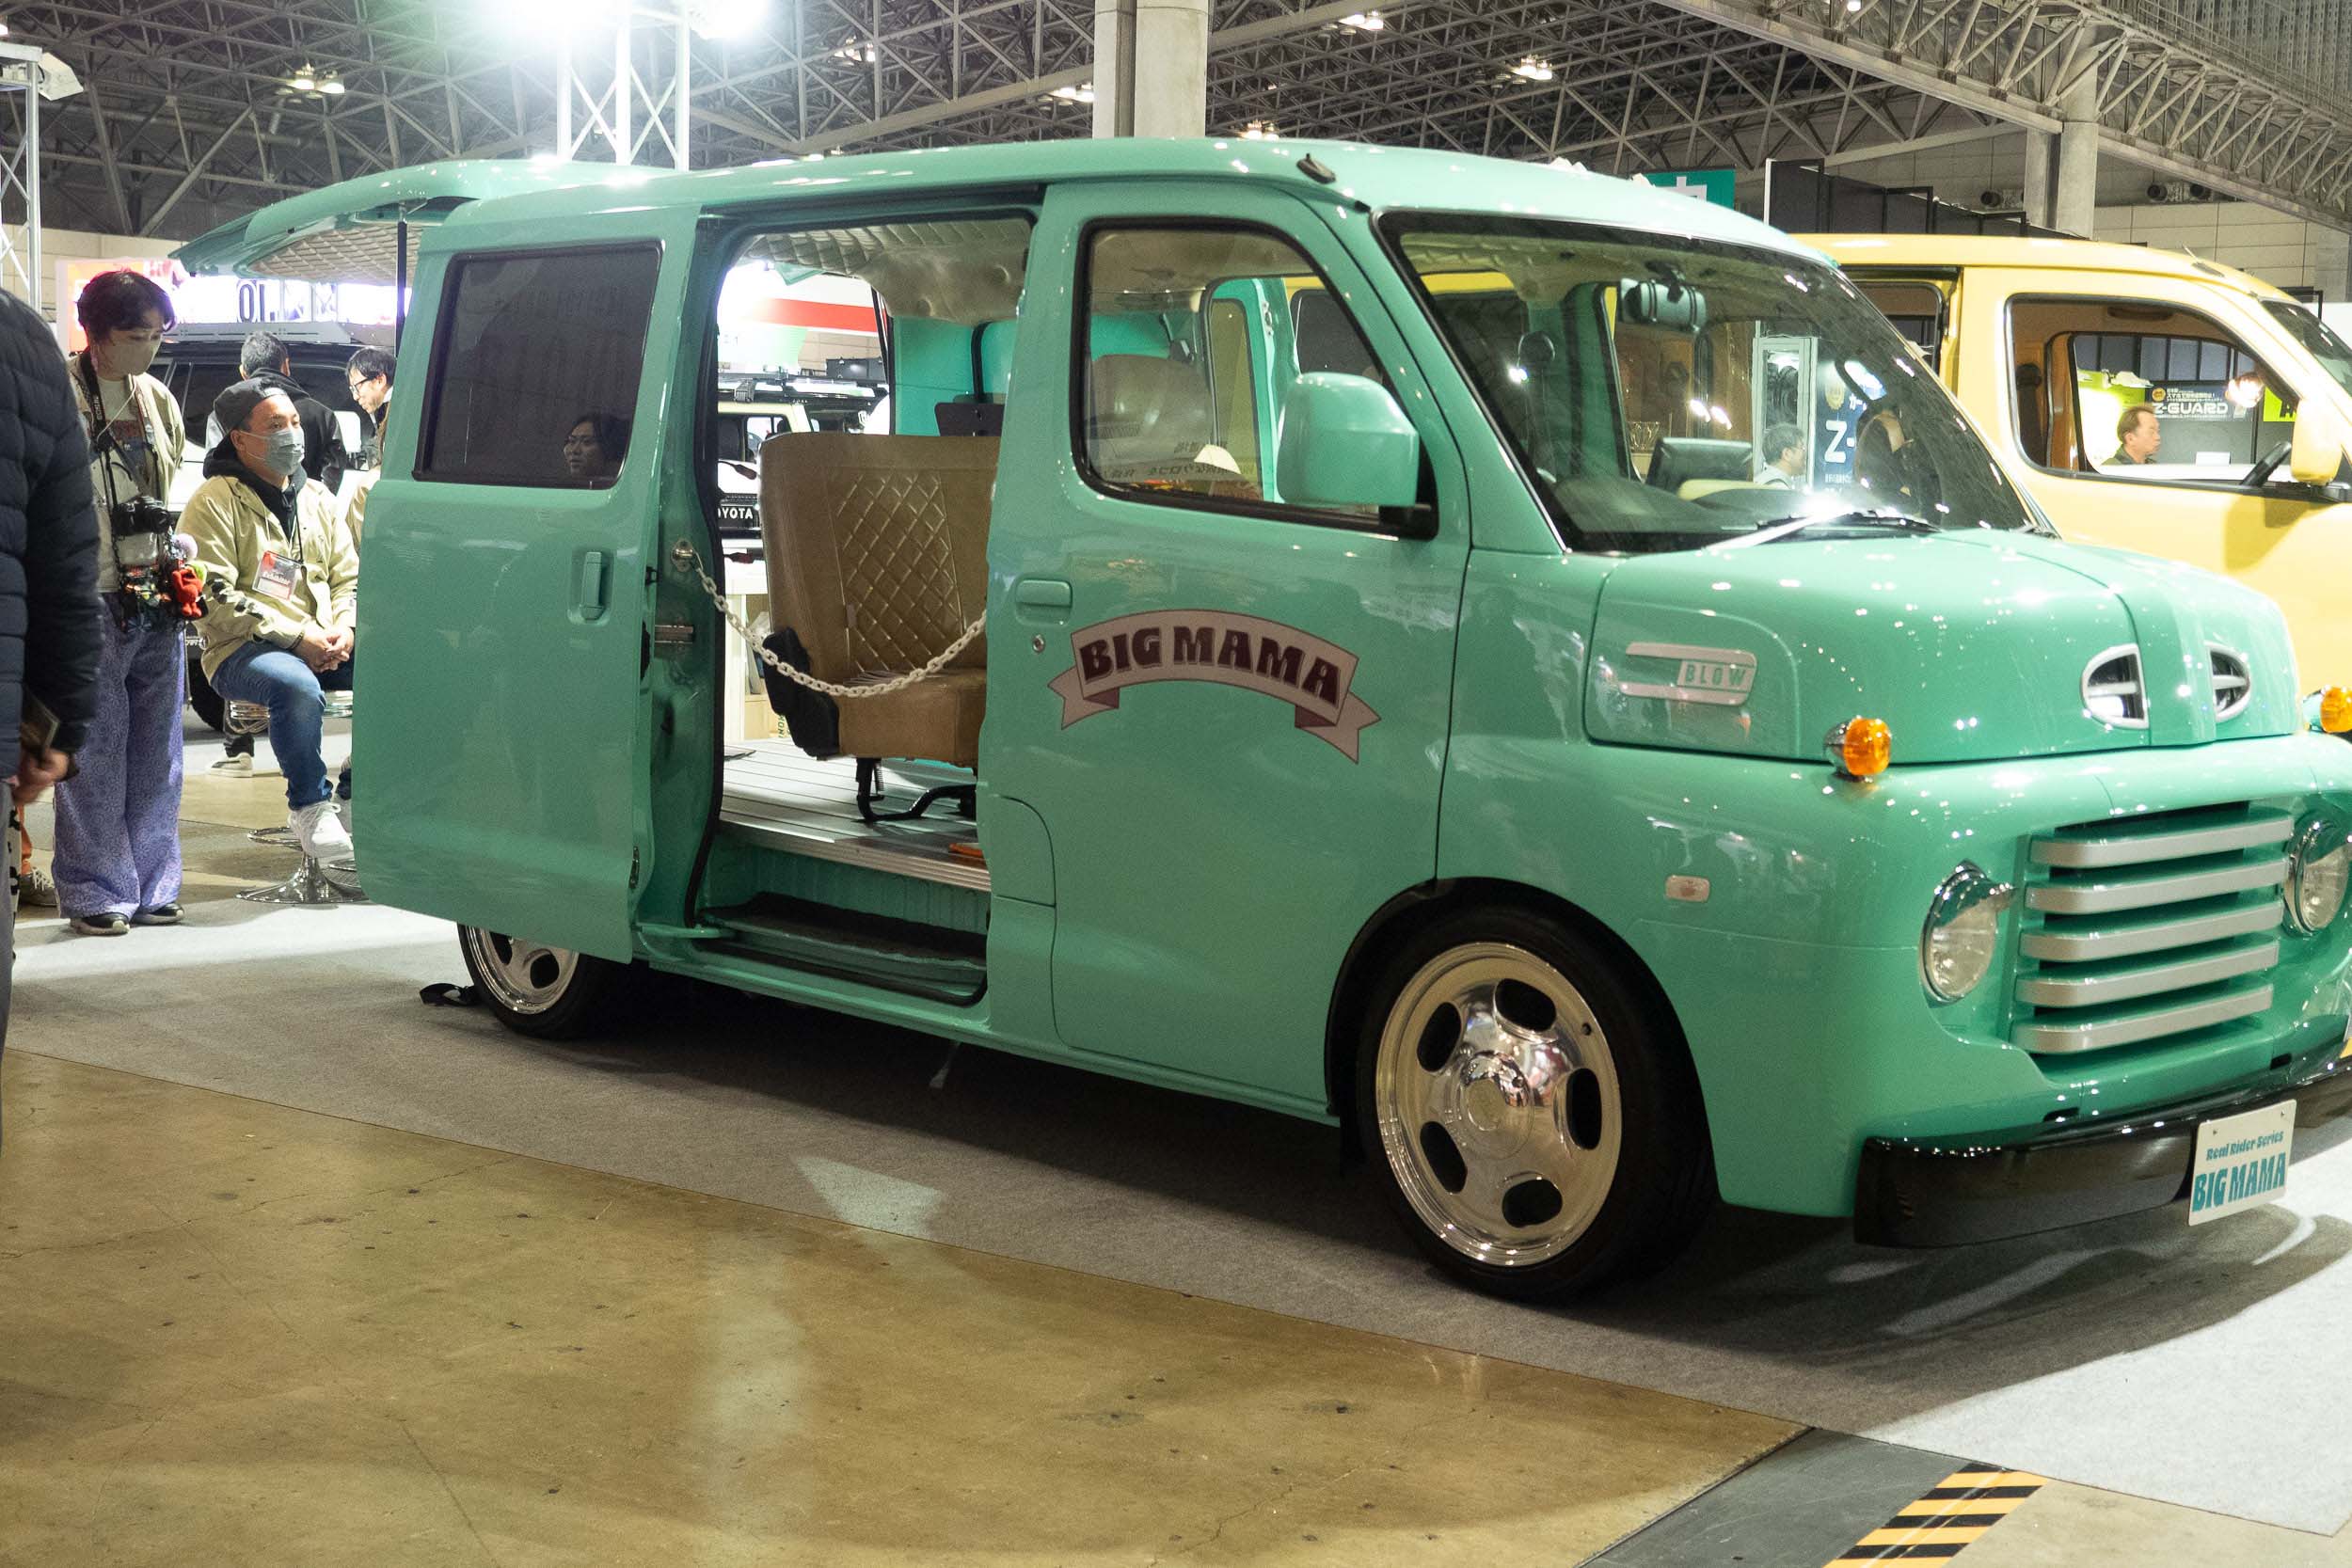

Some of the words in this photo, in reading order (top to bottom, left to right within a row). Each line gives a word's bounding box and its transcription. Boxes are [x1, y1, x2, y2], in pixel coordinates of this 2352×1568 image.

[2153, 403, 2229, 415] Z-GUARD
[1079, 627, 1163, 685] BIG
[1173, 626, 1341, 707] MAMA
[1684, 663, 1746, 686] BLOW
[2206, 1144, 2229, 1161] Real
[2230, 1139, 2255, 1156] Rider
[2257, 1130, 2284, 1149] Series
[2191, 1167, 2229, 1212] BIG
[2228, 1152, 2286, 1203] MAMA
